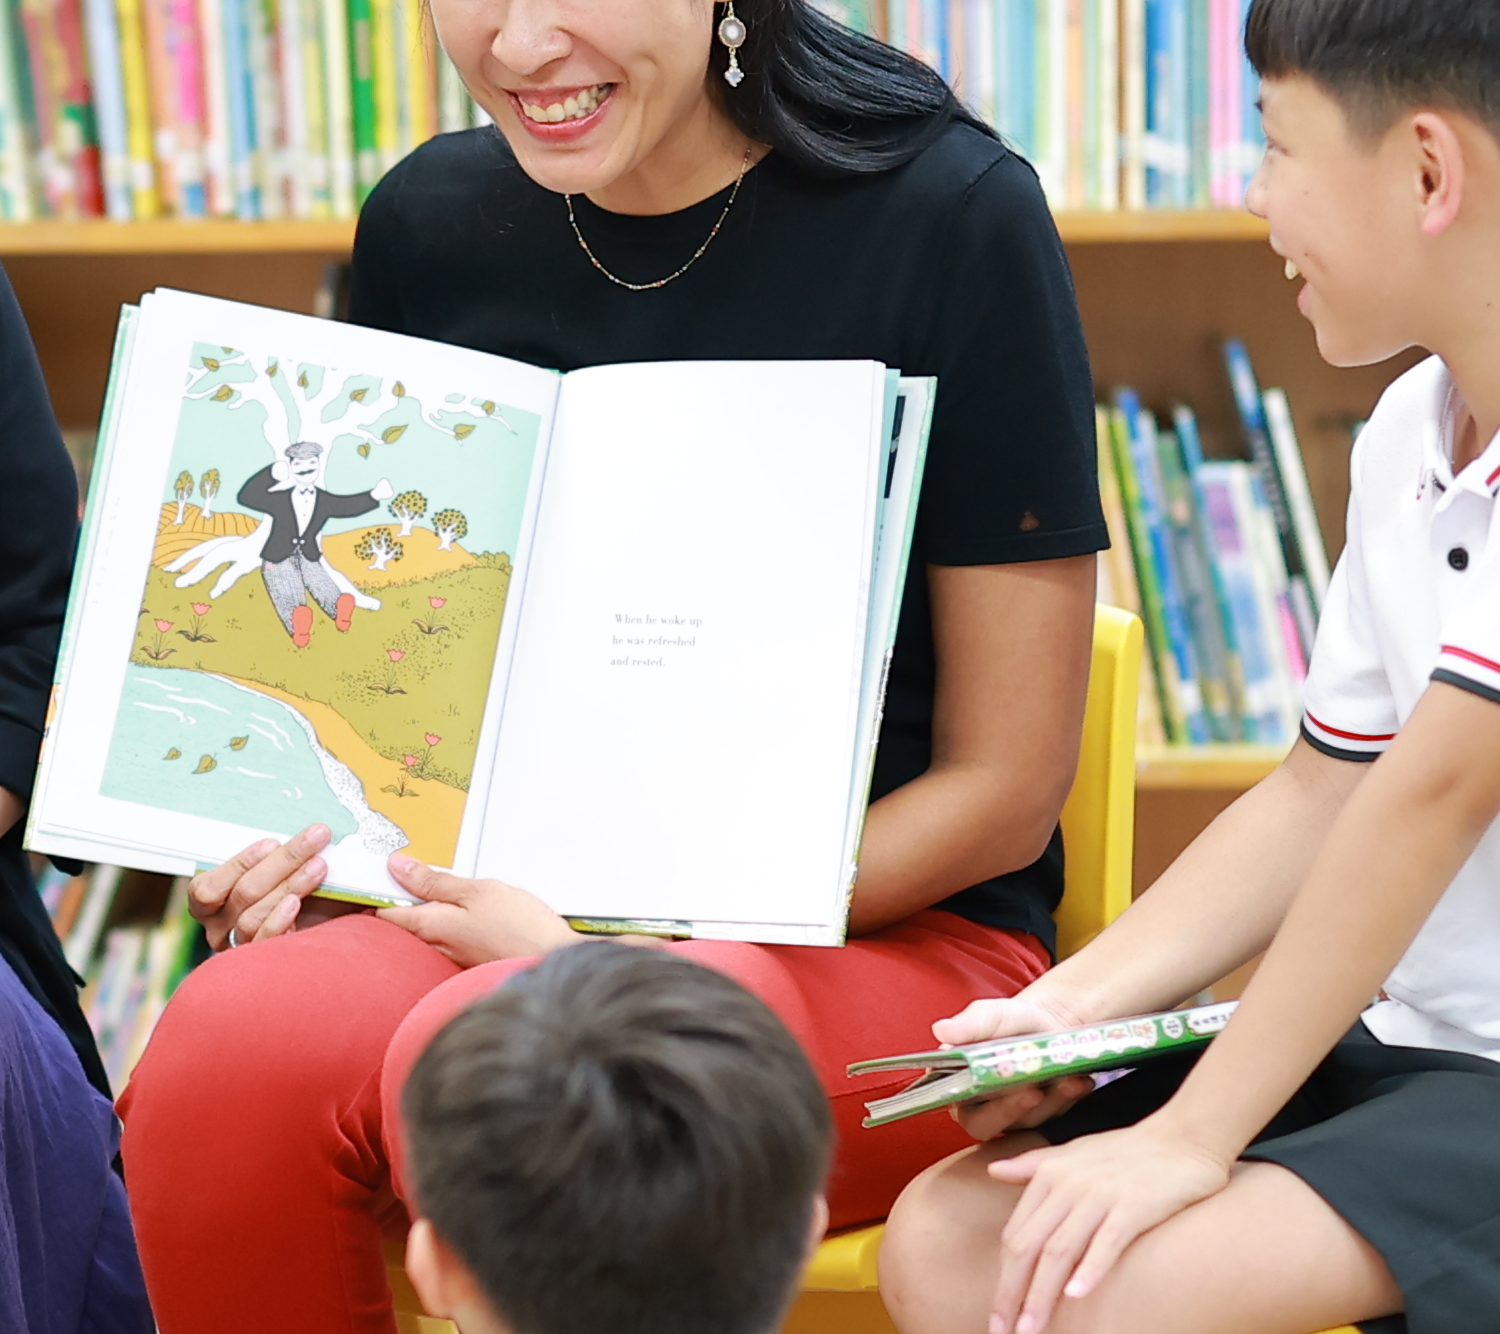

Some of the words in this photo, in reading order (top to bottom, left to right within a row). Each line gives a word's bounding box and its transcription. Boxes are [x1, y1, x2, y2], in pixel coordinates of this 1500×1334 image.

[615, 613, 642, 625] When
[645, 614, 658, 625] he
[660, 614, 687, 626] woke
[689, 617, 703, 629] up
[612, 634, 624, 645] he
[626, 637, 645, 646] was
[647, 635, 696, 647] refreshed
[610, 655, 629, 666] and
[631, 656, 666, 667] rested.
